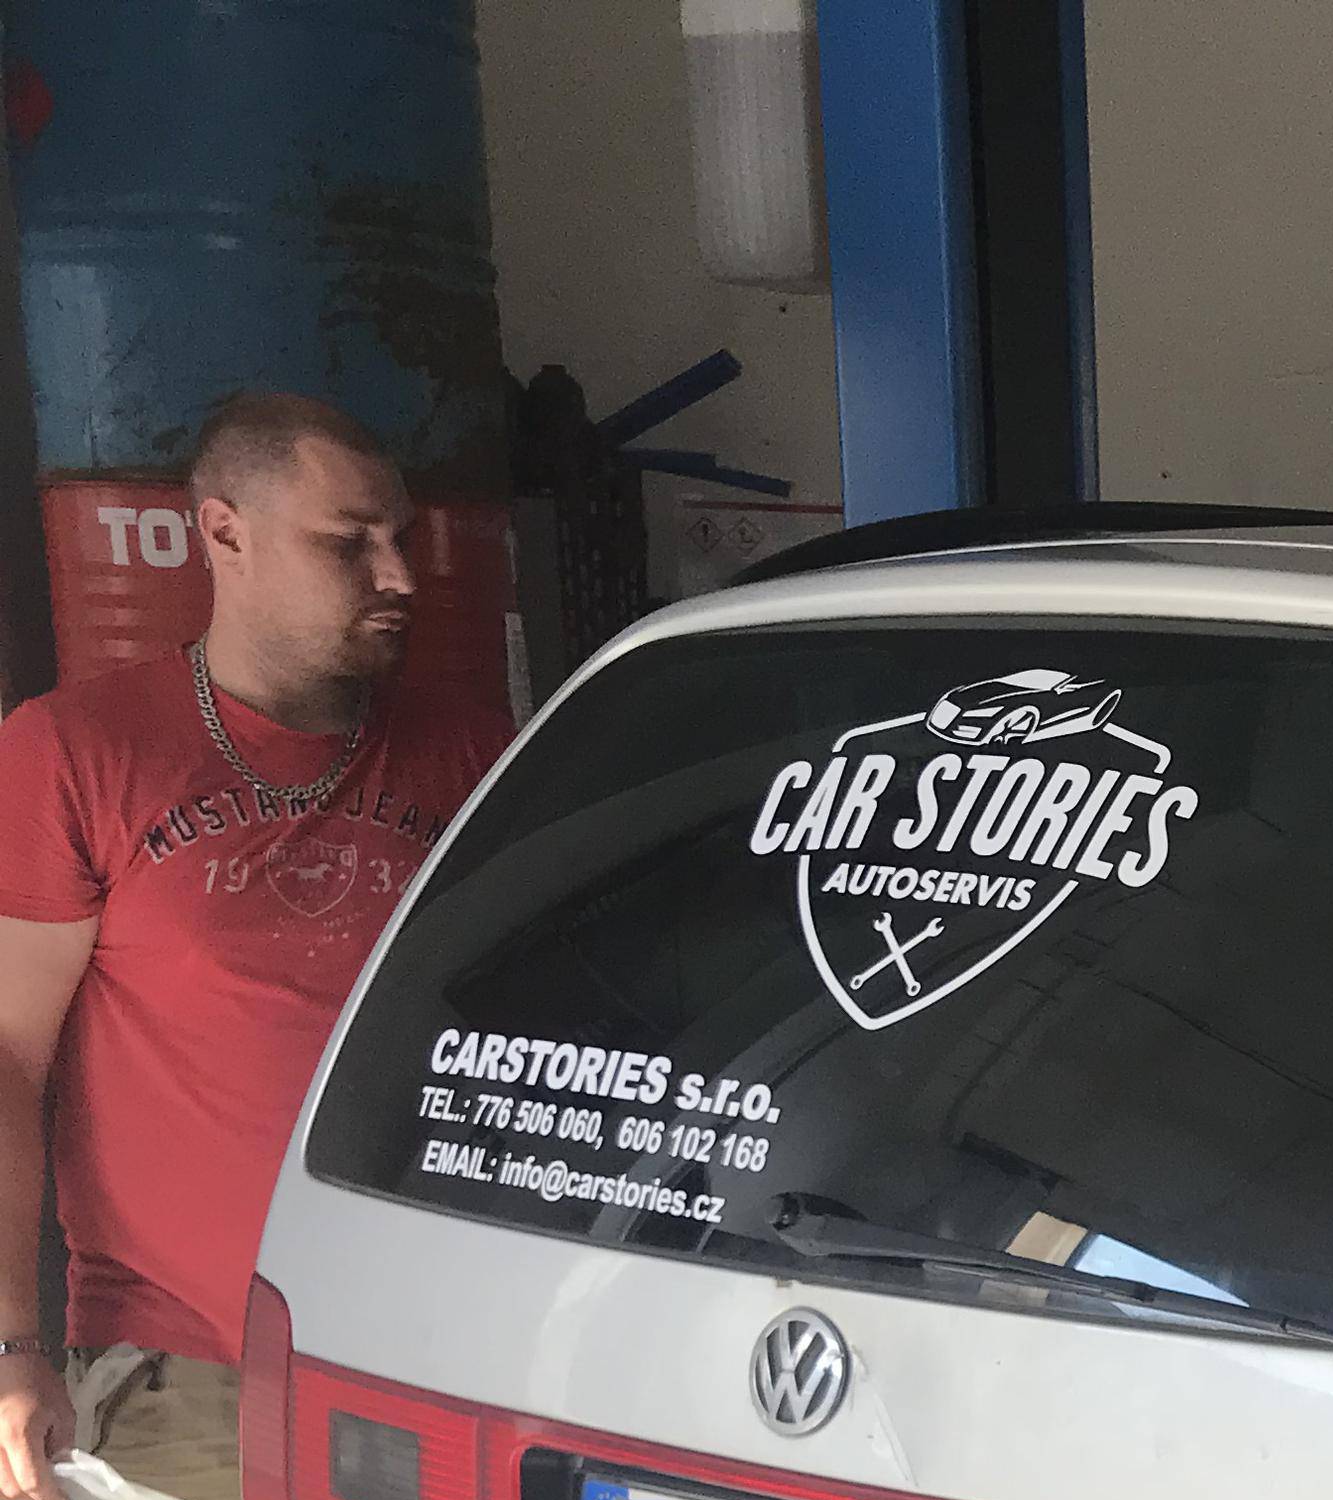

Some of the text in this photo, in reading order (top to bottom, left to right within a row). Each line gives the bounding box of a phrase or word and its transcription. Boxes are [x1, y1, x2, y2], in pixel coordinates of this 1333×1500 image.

[96, 506, 195, 569] TO
[749, 753, 1199, 888] CAR STORIES
[821, 862, 1038, 912] AUTOSERVIS
[430, 1028, 782, 1125] CARSTORIES s.r.o.
[417, 1085, 771, 1173] TEL.: 776 506 060, 606 102 168
[420, 1139, 727, 1224] EMAIL: info@carstories.cz
